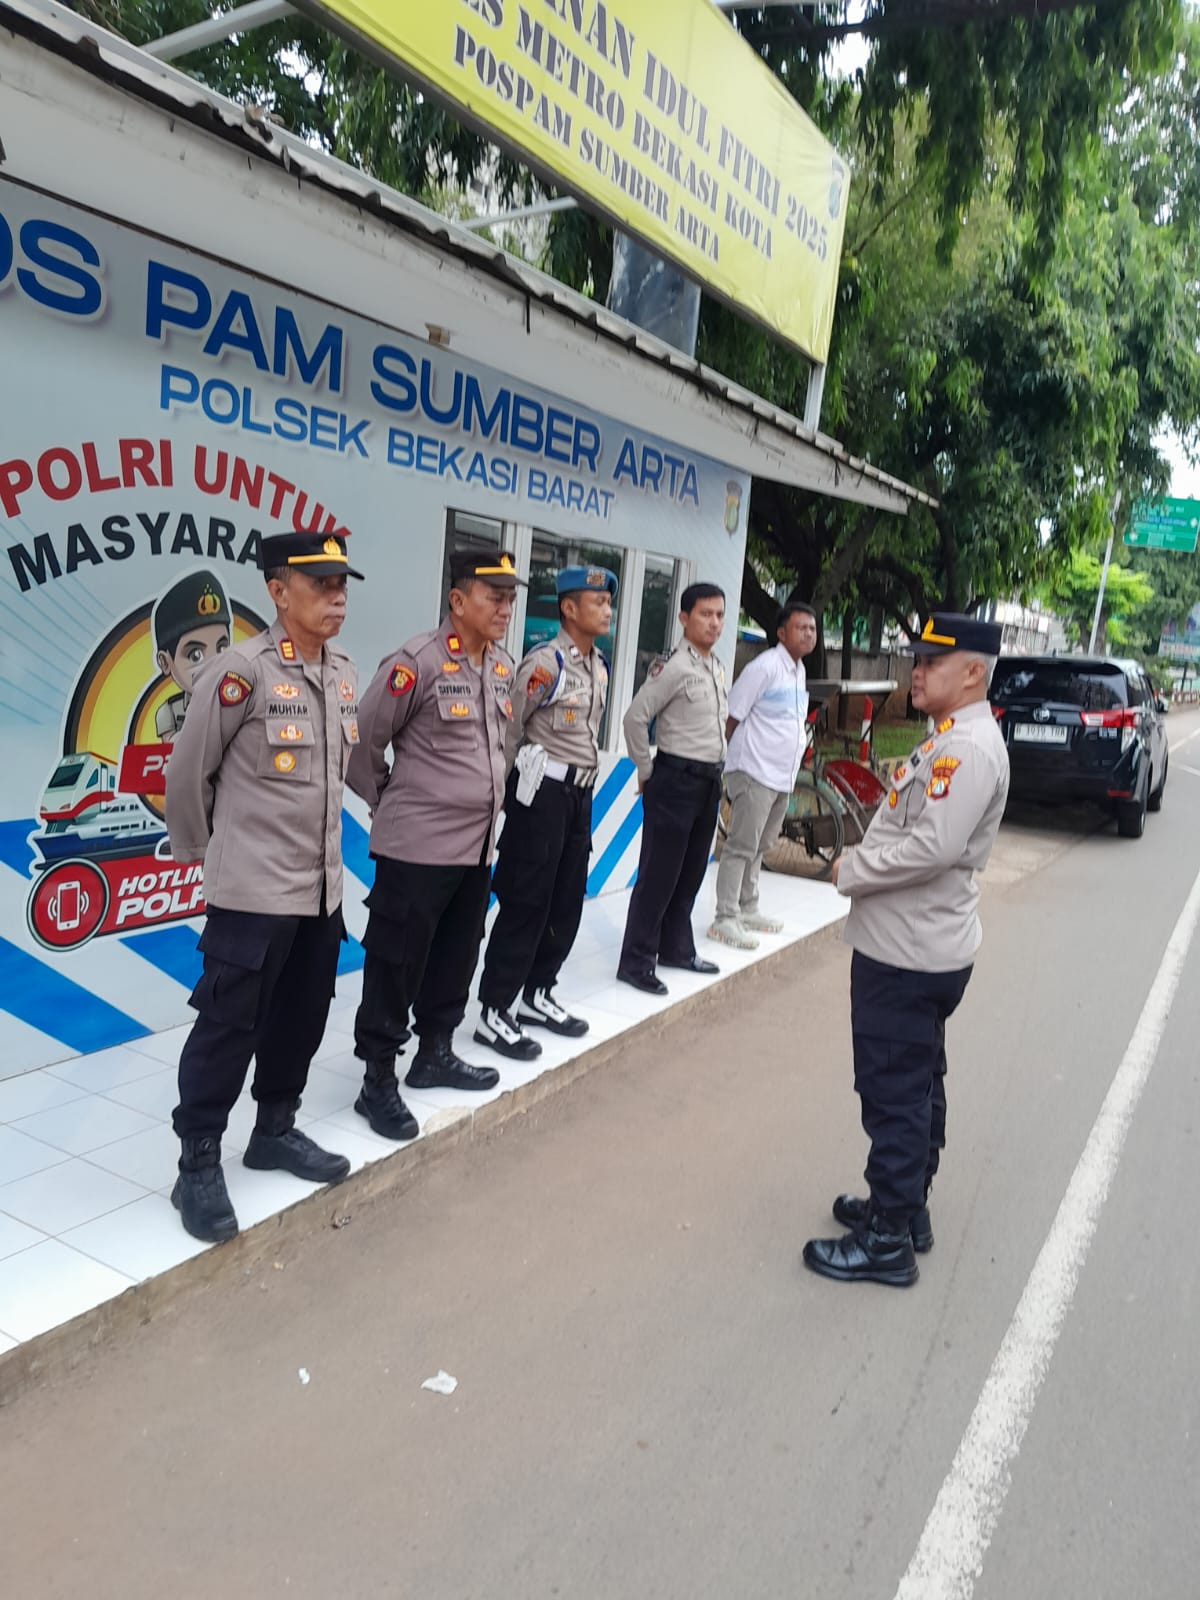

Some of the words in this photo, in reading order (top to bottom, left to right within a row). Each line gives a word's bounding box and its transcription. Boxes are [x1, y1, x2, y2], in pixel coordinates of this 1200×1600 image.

[453, 25, 572, 149] POSPAM
[578, 128, 670, 224] SUMBER
[674, 205, 720, 262] ARTA
[515, 9, 626, 132] METRO
[632, 111, 718, 214] BEKASI
[724, 177, 773, 258] KOTA
[543, 0, 636, 80] NAN
[641, 51, 712, 154] IDUL
[717, 125, 781, 217] FITRI
[784, 193, 829, 263] 2025
[0, 212, 102, 316] S
[145, 260, 344, 392] PAM
[370, 343, 600, 472] SUMBER
[613, 438, 700, 506] ARTA
[160, 363, 371, 458] POLSEK
[387, 427, 518, 494] BEKASI
[527, 468, 615, 519] BARAT
[0, 438, 173, 518] POLRI
[268, 703, 309, 716] MUHTAR
